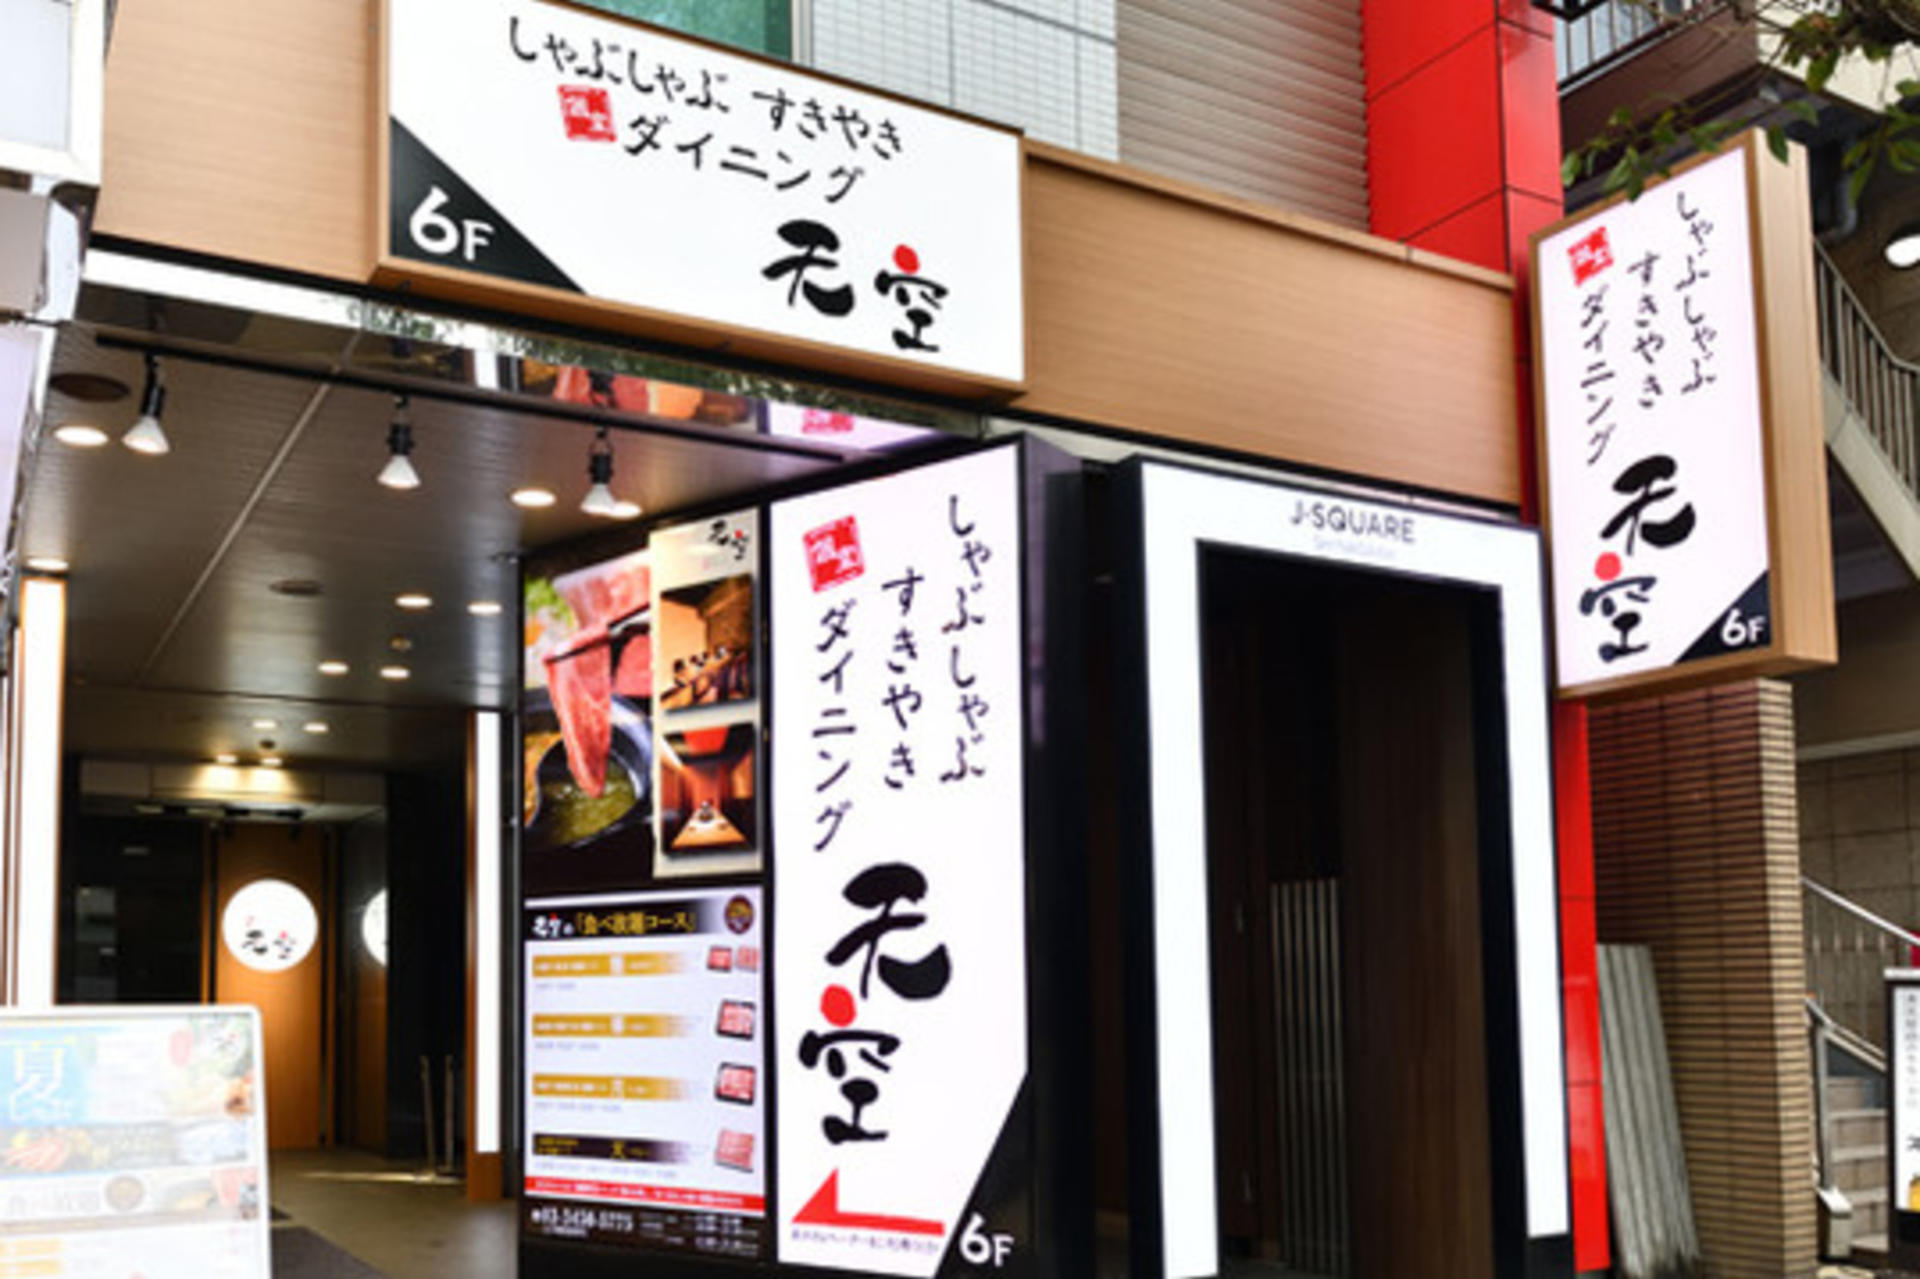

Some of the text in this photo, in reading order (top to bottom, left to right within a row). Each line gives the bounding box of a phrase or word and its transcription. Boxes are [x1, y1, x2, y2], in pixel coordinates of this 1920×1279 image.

[509, 16, 903, 160] しゃぶしゃぶ すきやき
[623, 114, 866, 203] ダイニング
[409, 187, 494, 262] 6F
[1675, 192, 1717, 393] しゃぶしゃぶ
[1580, 283, 1616, 465] ダイニング
[1627, 251, 1665, 408] すきやき
[881, 566, 924, 790] すきやき
[939, 495, 992, 783] しゃぶしゃぶ
[1720, 608, 1766, 646] 6F
[812, 598, 858, 852] ダイニング
[960, 1213, 1014, 1267] 6F
